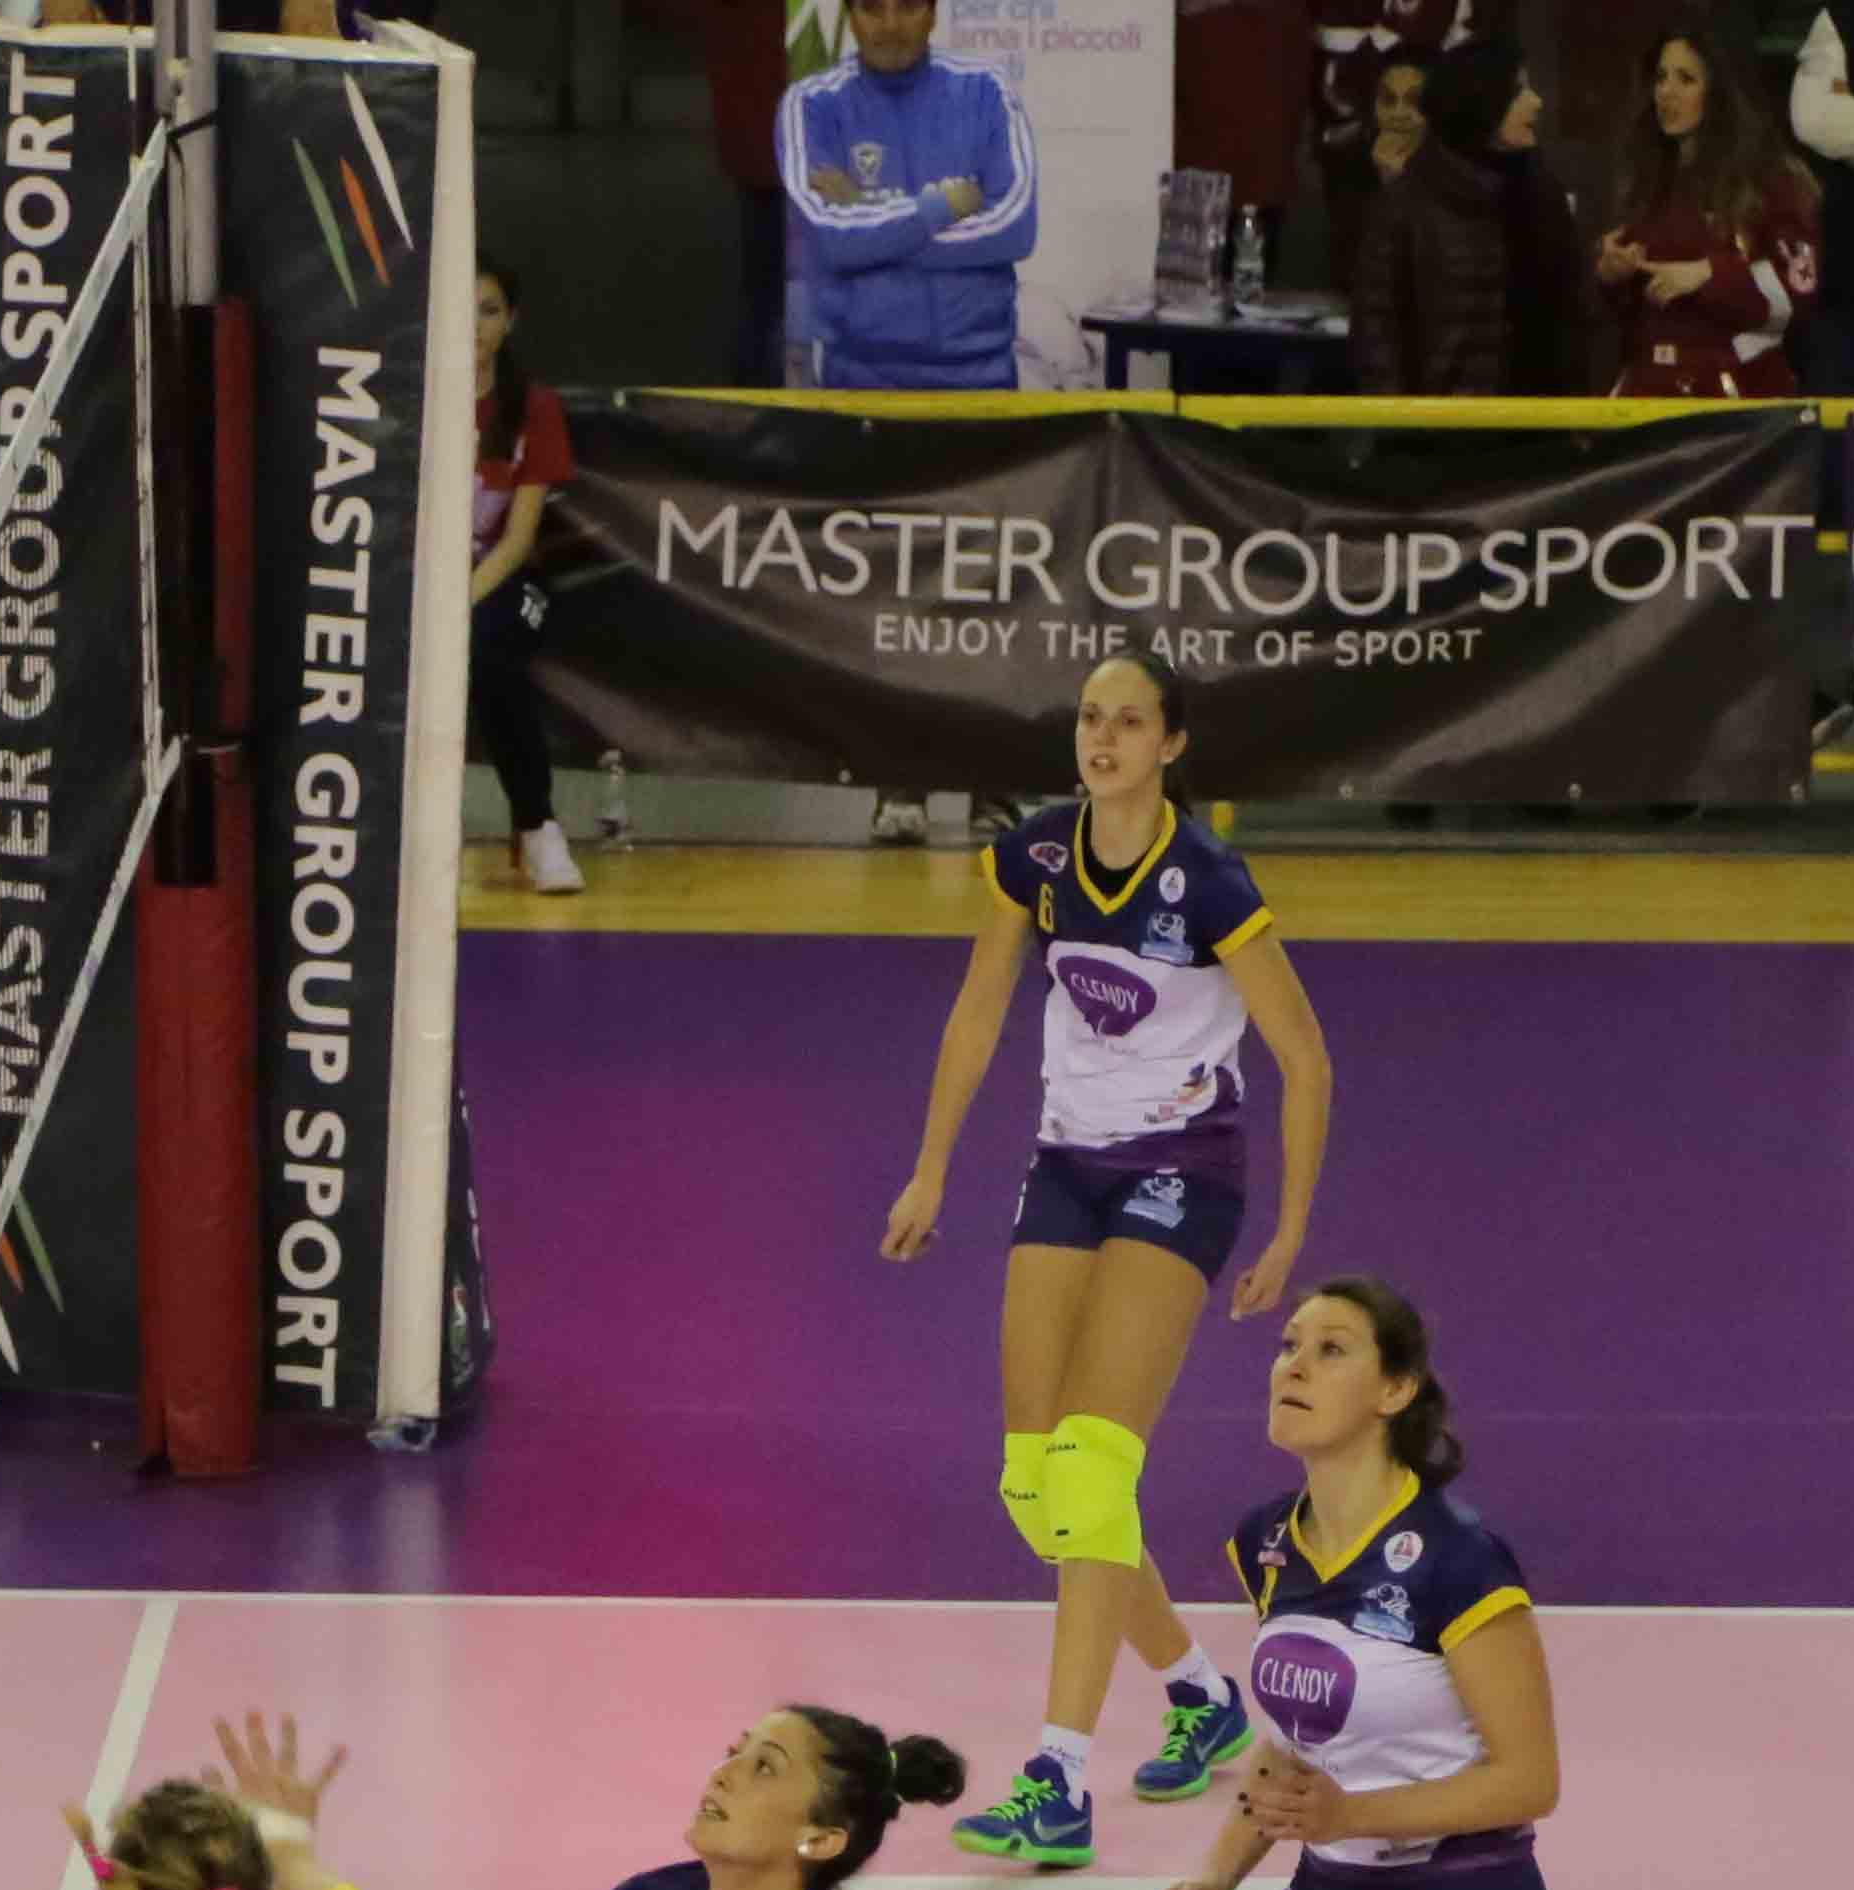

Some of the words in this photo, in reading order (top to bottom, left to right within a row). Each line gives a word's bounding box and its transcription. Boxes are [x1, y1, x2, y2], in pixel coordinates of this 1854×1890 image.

[1, 52, 77, 370] SPORT
[296, 347, 382, 726] MASTER
[656, 501, 1057, 605] MASTER
[1086, 525, 1461, 617] GROUP
[1478, 516, 1815, 611] SPORT
[873, 611, 1017, 659] ENJOY
[1039, 619, 1128, 663] THE
[1149, 626, 1228, 668] ART
[1255, 628, 1315, 669] OF
[1334, 627, 1484, 669] SPORT
[286, 752, 361, 1084] GROUP
[1069, 971, 1140, 1015] CLENDY
[275, 1109, 348, 1408] SPORT
[1258, 1655, 1339, 1709] CLENDY
